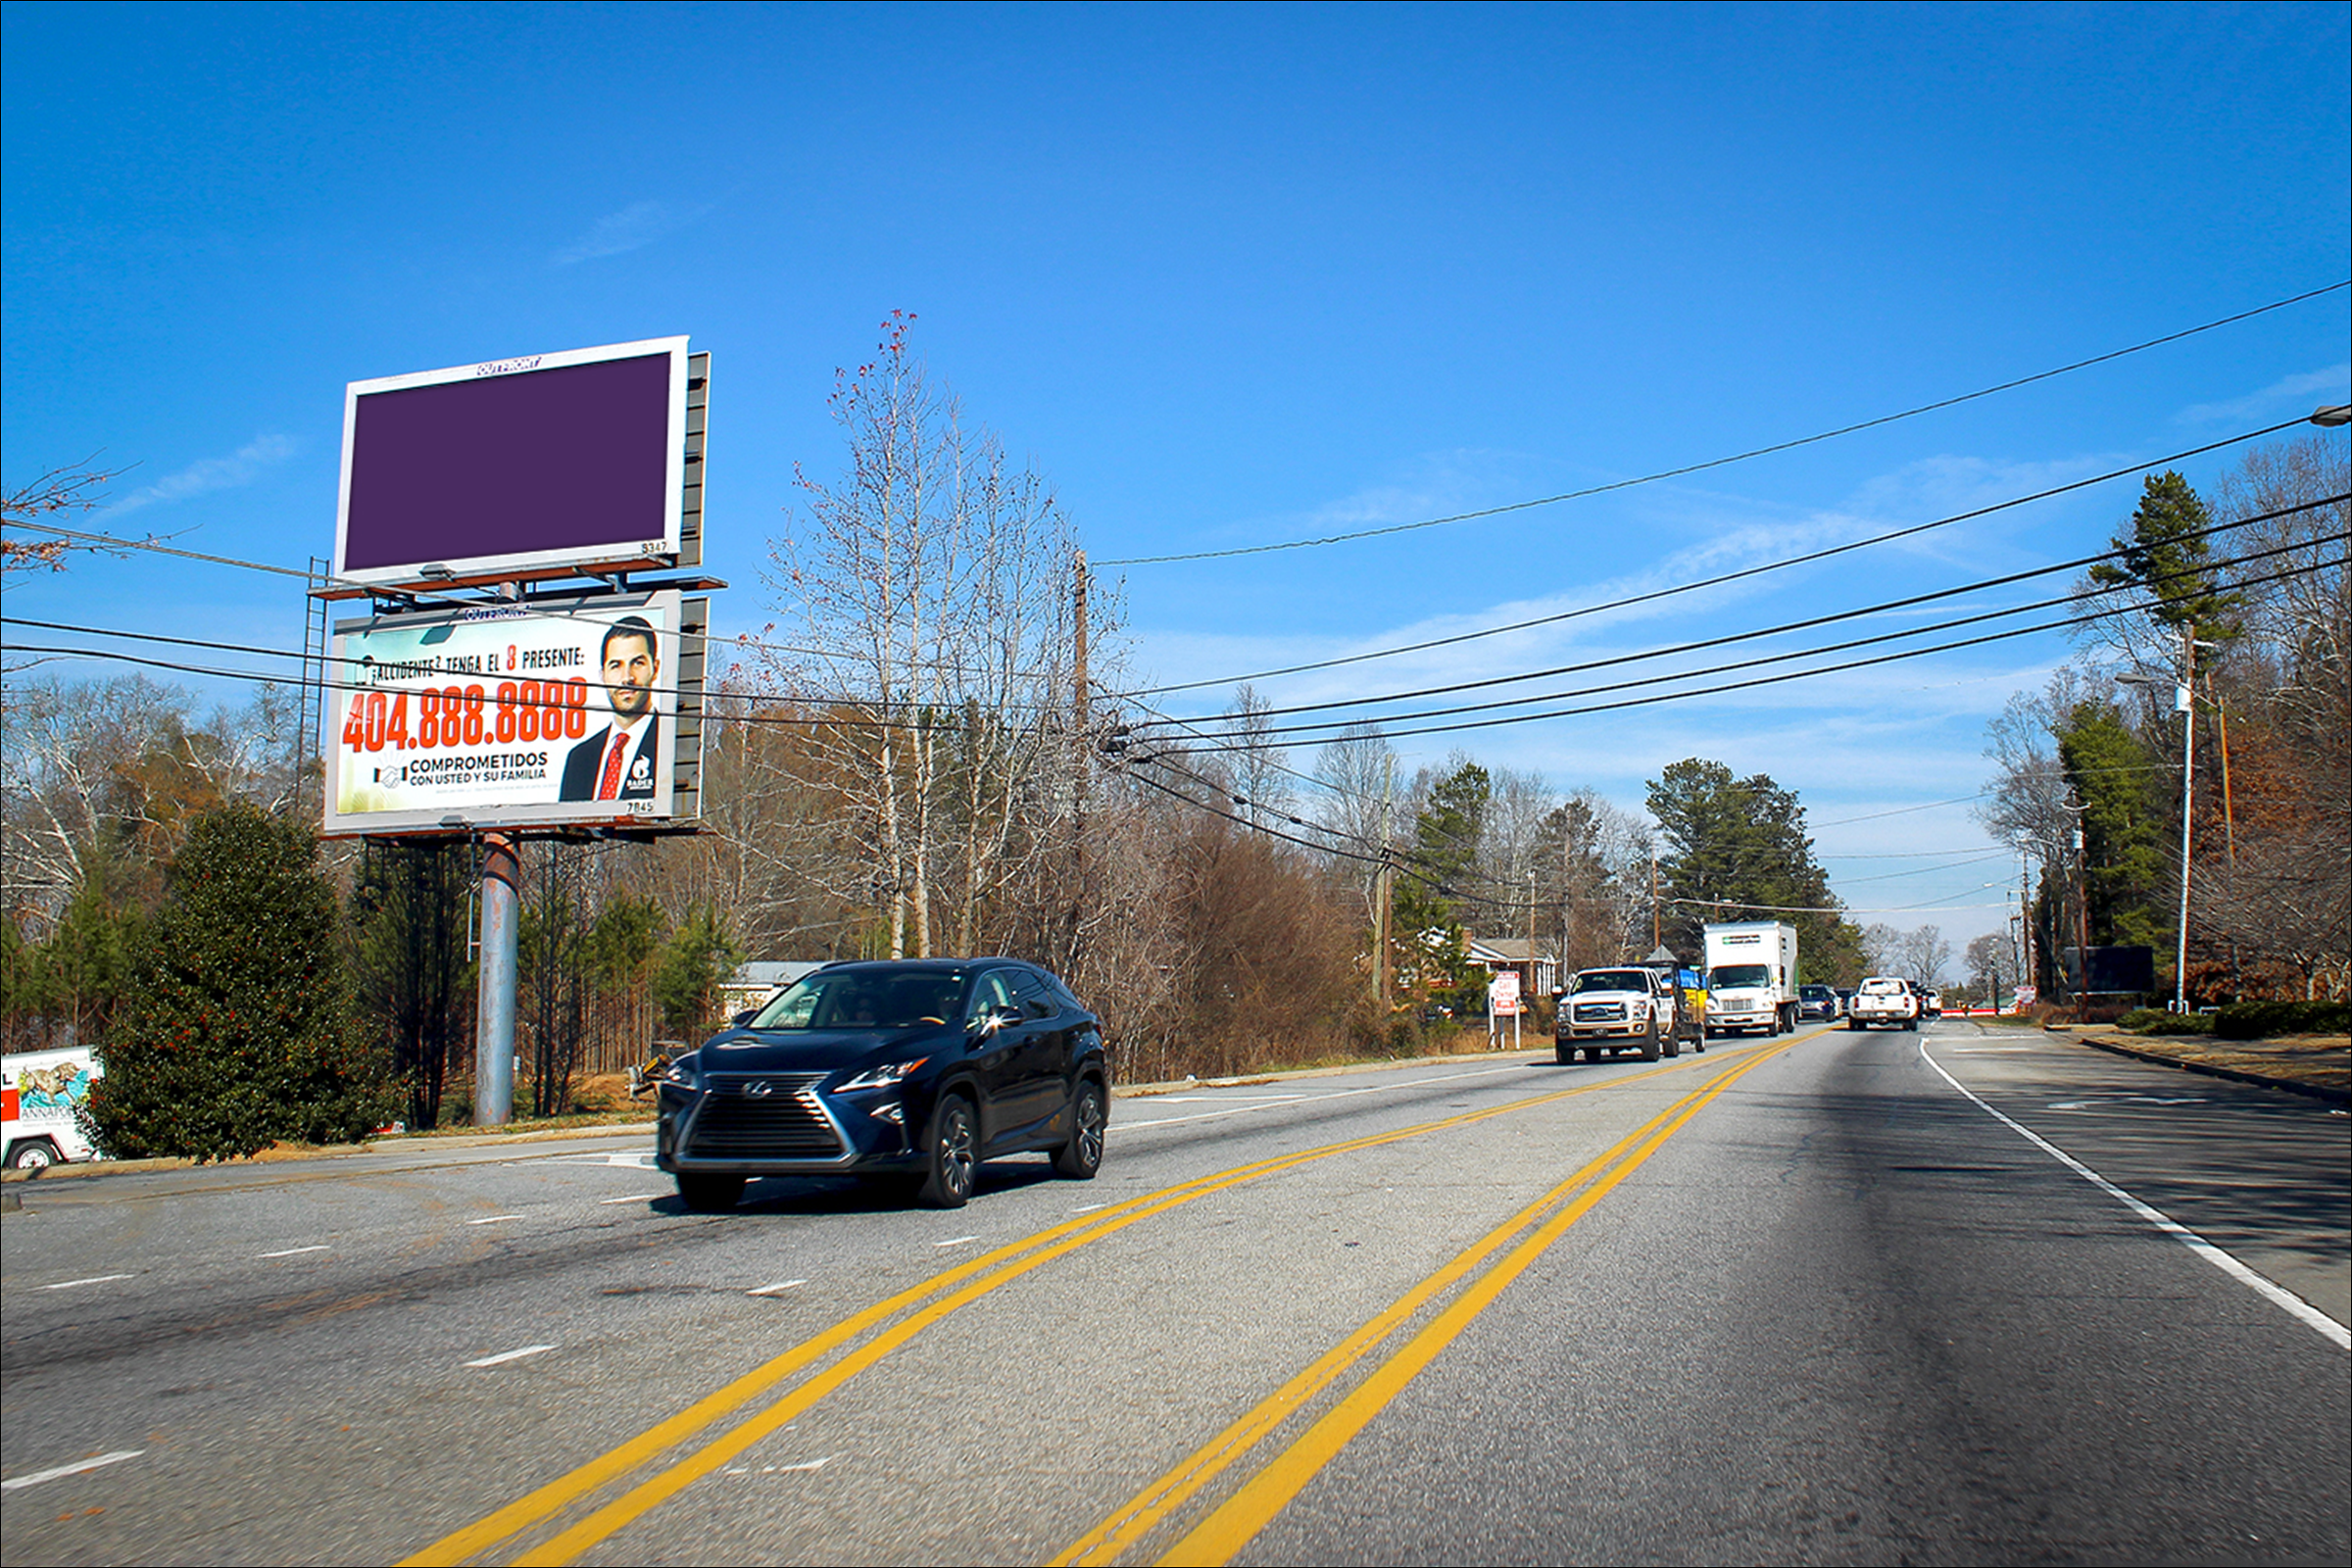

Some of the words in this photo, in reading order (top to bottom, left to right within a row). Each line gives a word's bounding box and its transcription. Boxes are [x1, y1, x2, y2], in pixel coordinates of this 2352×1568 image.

[476, 356, 542, 375] OUTFRONT
[446, 655, 481, 674] TENGA
[488, 654, 500, 672] EL
[507, 644, 516, 671] 8
[522, 647, 585, 669] PRESENTE:
[342, 676, 588, 753] 404.888.8888
[410, 752, 549, 773] COMPROMETIDOS
[410, 774, 434, 786] CON
[435, 771, 473, 785] USTED
[474, 772, 481, 782] Y
[483, 770, 500, 782] SU
[501, 768, 547, 781] FAMILIA
